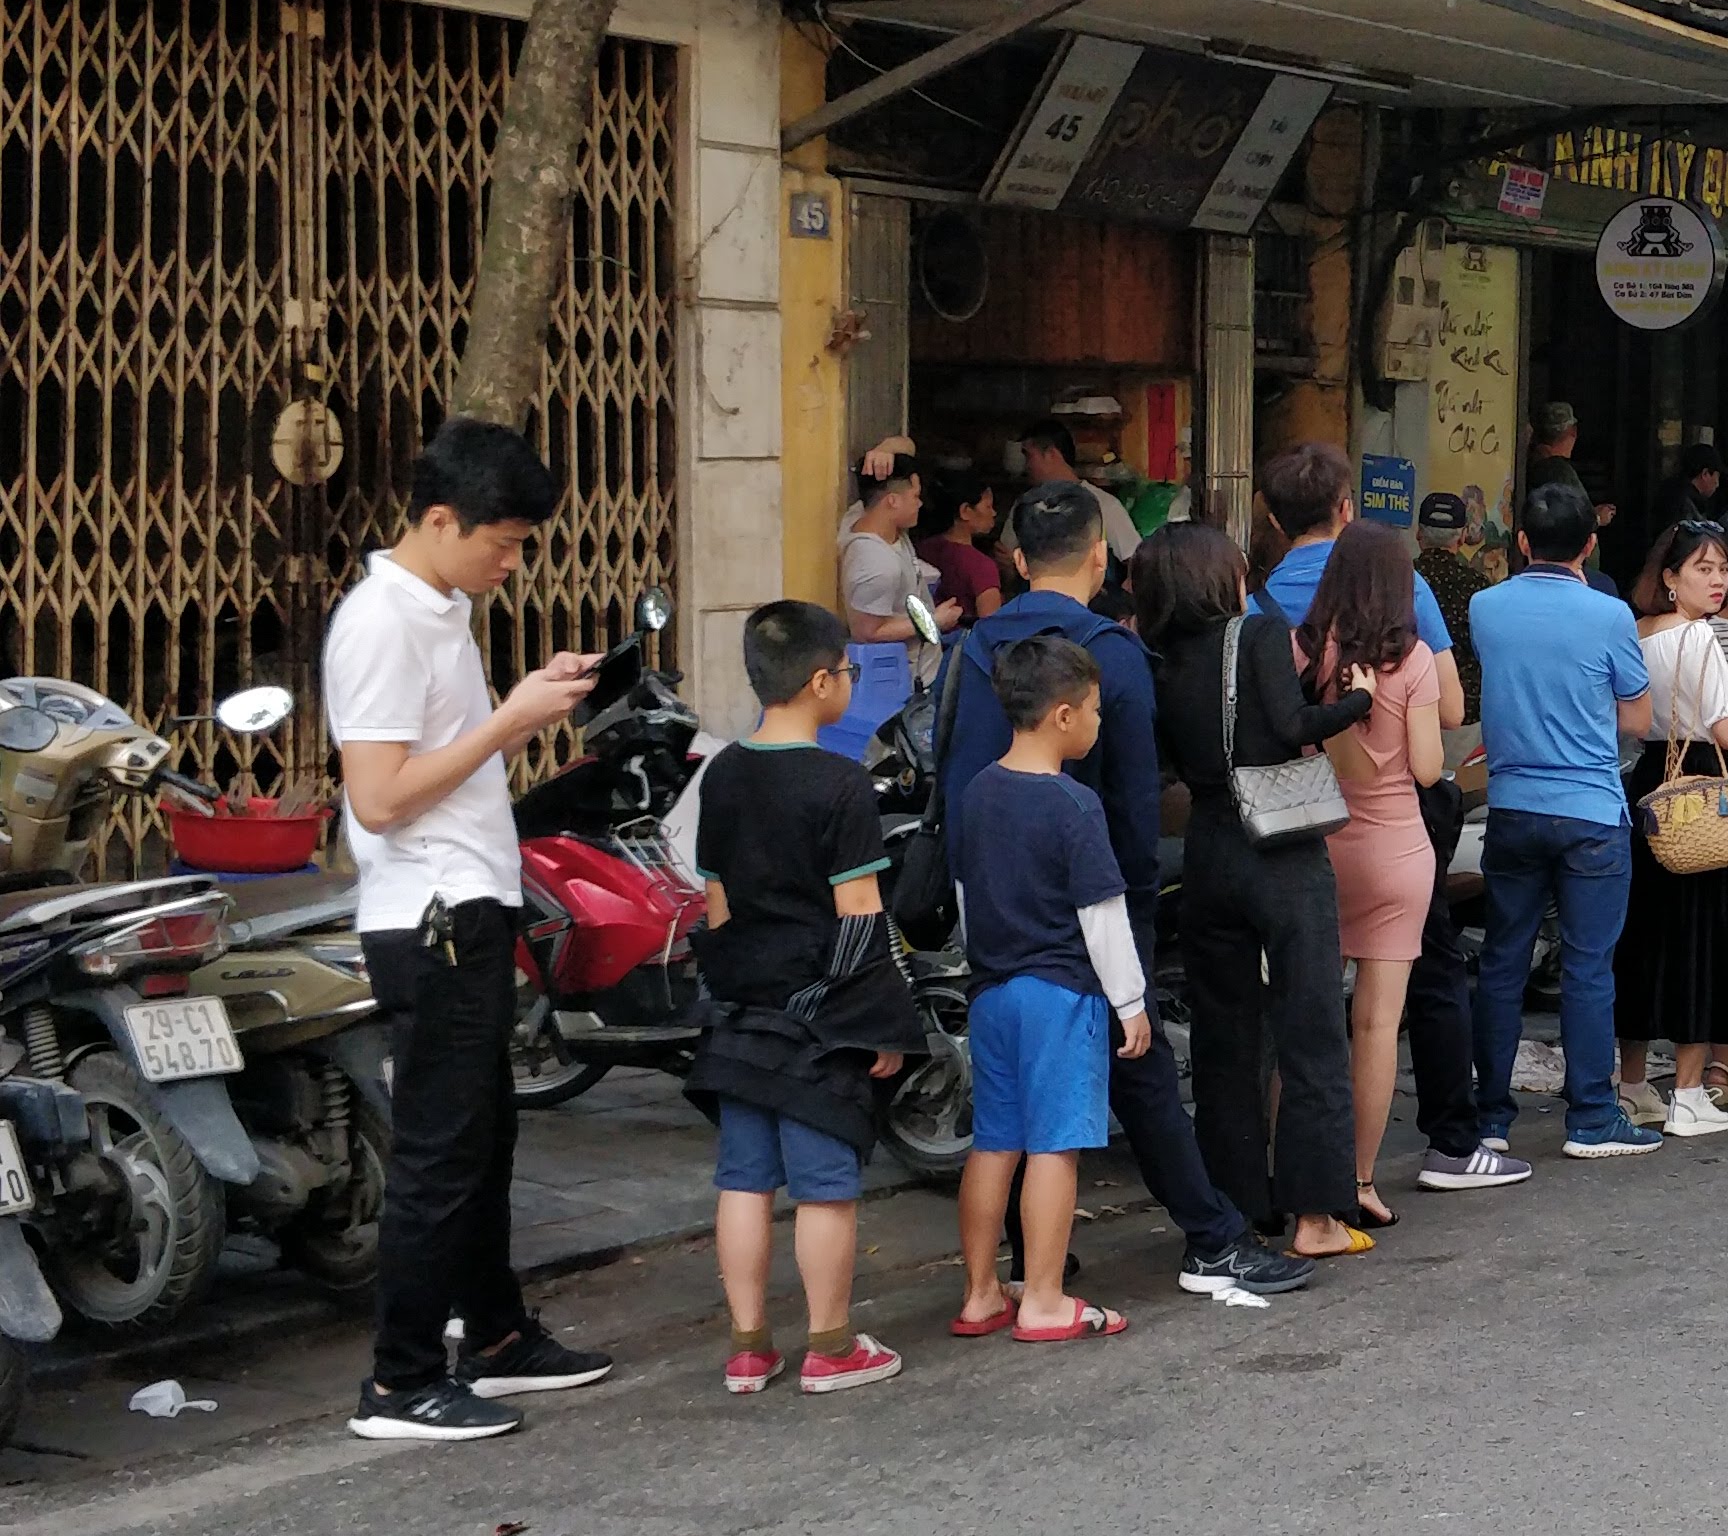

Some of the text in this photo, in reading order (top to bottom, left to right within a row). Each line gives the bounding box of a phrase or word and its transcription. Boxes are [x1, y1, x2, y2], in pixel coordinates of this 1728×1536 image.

[1045, 114, 1083, 142] 45
[797, 202, 825, 231] 45
[1364, 491, 1386, 509] SIM
[141, 1005, 216, 1041] 29-C1
[144, 1037, 235, 1076] 548.70
